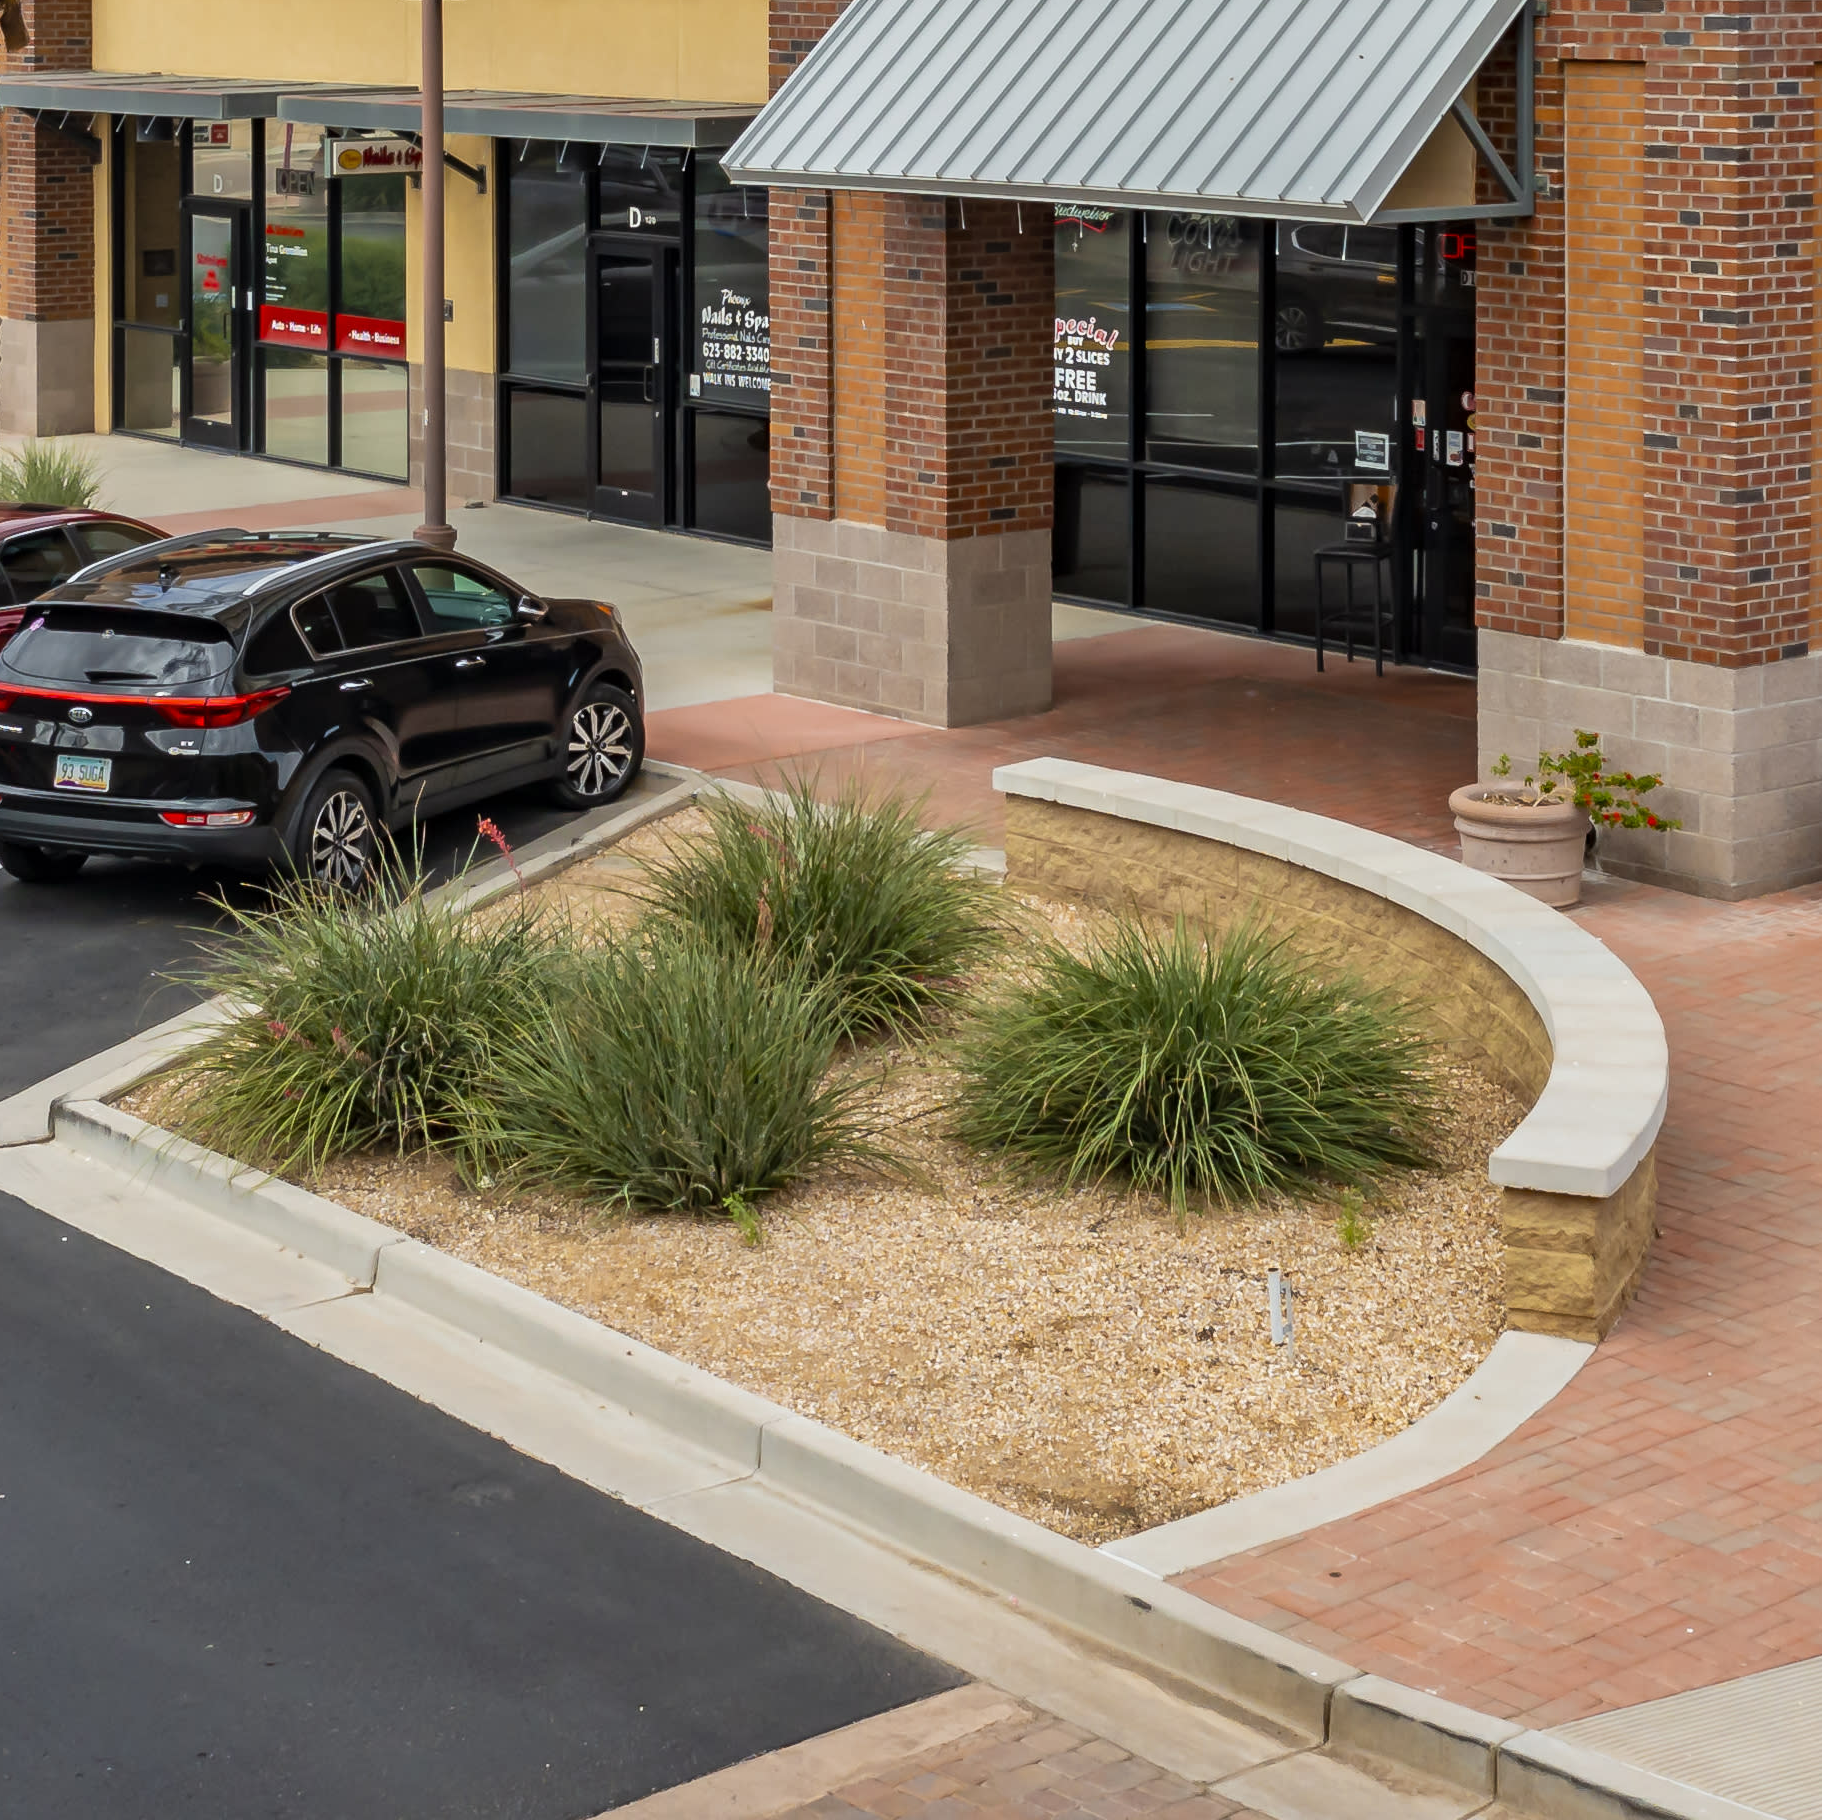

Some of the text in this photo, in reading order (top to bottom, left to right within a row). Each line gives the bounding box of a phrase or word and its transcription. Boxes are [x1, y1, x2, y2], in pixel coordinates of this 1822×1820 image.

[279, 170, 315, 195] OPEN
[701, 306, 733, 326] Nails
[744, 310, 770, 332] Spa
[310, 323, 322, 335] Life
[374, 332, 400, 345] Business
[1054, 316, 1120, 351] pecial
[1067, 335, 1084, 346] BUY
[702, 342, 770, 362] 623-882-3340
[1065, 346, 1075, 364] 2
[1075, 350, 1111, 366] SLICES
[702, 372, 722, 386] WALK
[738, 376, 771, 391] WELCOME
[1054, 367, 1097, 391] FREE
[1074, 390, 1107, 406] DRINK
[61, 763, 75, 779] 93
